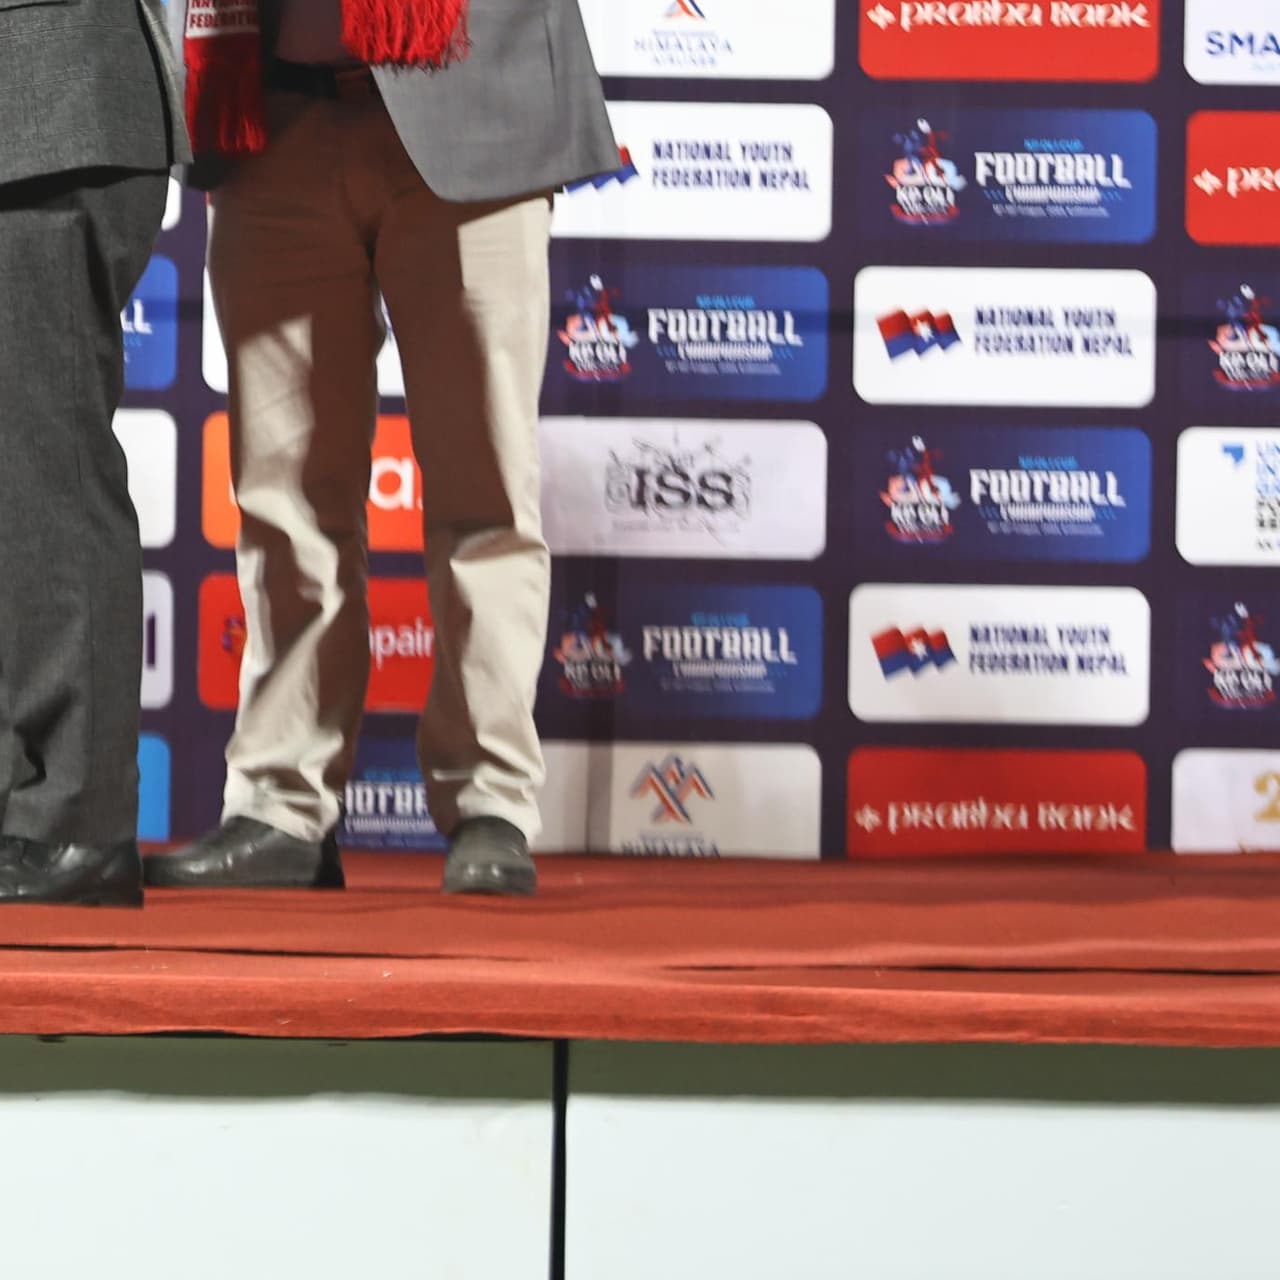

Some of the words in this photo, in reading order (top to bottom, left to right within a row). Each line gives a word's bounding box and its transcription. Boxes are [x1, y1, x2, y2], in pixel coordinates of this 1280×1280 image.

[1204, 30, 1280, 57] SMA
[651, 140, 733, 162] NATIONAL
[738, 141, 794, 163] YOUTH
[650, 168, 753, 190] FEDERATION
[757, 169, 811, 192] NEPAL
[973, 150, 1133, 189] FOOTBALL
[646, 308, 805, 347] FOOTBALL
[974, 304, 1054, 328] NATIONAL
[1062, 306, 1118, 329] YOUTH
[973, 333, 1077, 356] FEDERATION
[1081, 334, 1134, 358] NEPAL
[969, 468, 1127, 508] FOOTBALL
[642, 625, 798, 665] FOOTBALL
[967, 622, 1049, 647] NATIONAL
[1055, 624, 1112, 647] YOUTH
[967, 651, 1071, 675] FEDERATION
[1077, 653, 1130, 677] NEPAL
